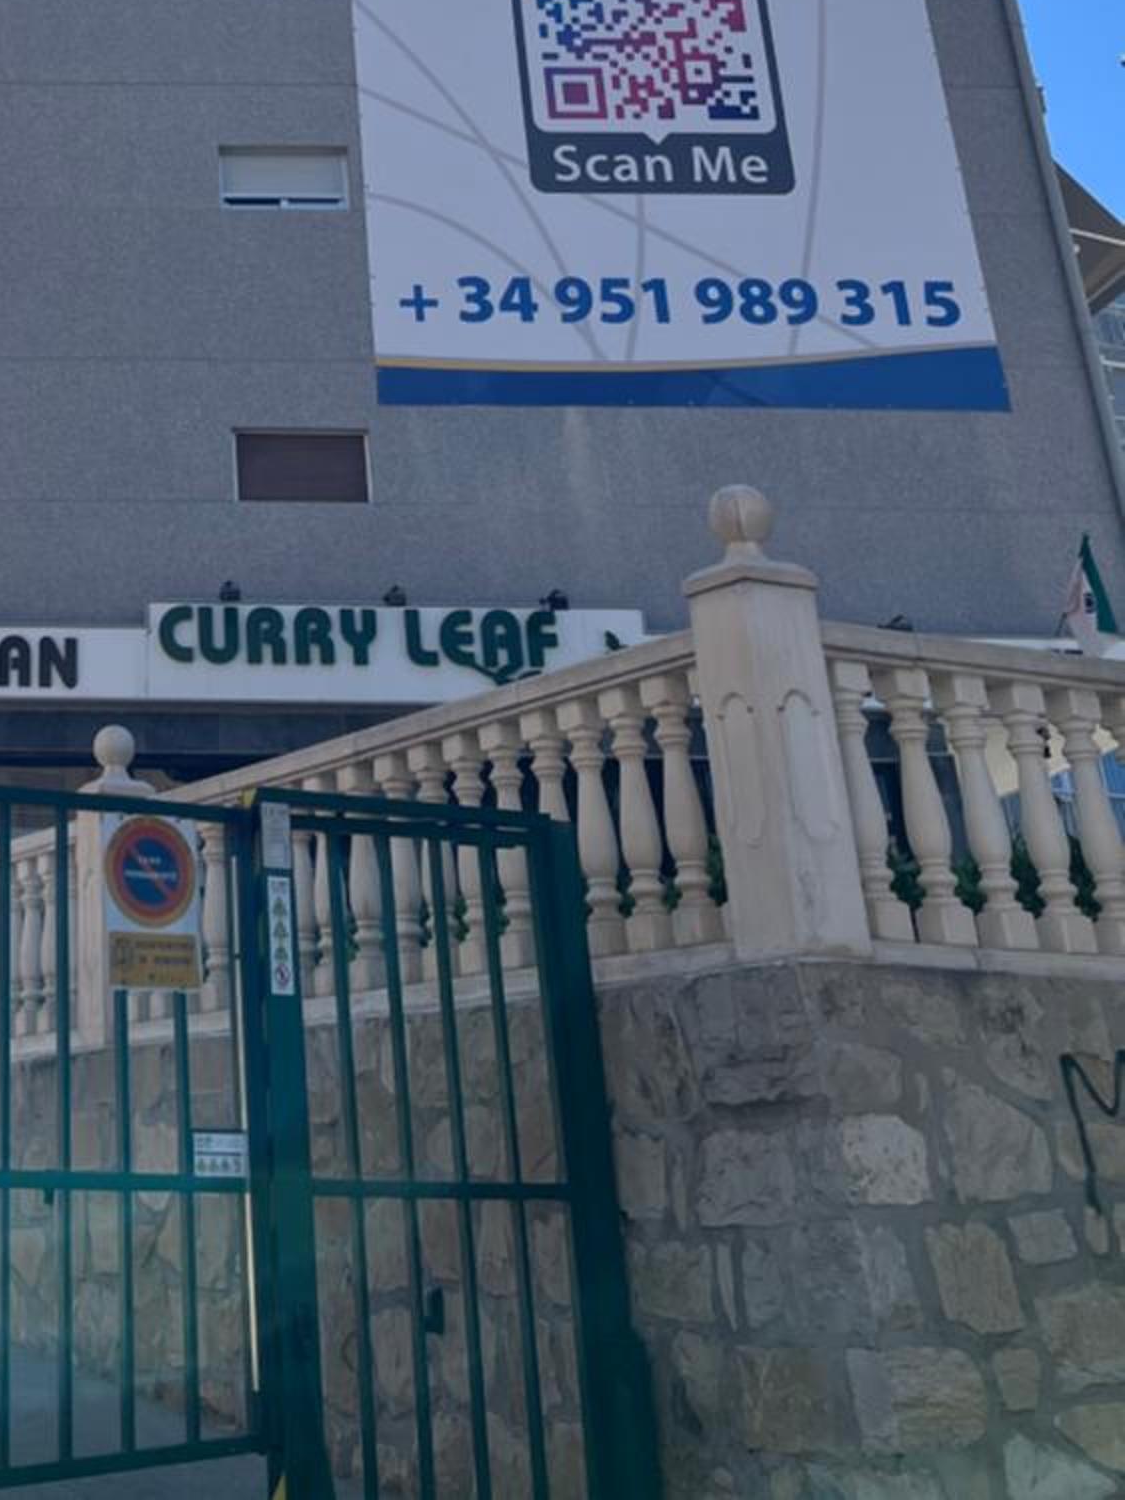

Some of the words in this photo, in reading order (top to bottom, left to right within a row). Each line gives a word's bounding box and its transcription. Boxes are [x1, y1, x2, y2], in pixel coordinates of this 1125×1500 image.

[553, 145, 674, 183] Scan
[692, 146, 769, 183] Me
[456, 276, 539, 324] 34
[553, 277, 671, 324] 951
[694, 278, 818, 326] 989
[836, 279, 961, 327] 315
[159, 606, 377, 665] CURRY
[405, 607, 559, 670] LEAF
